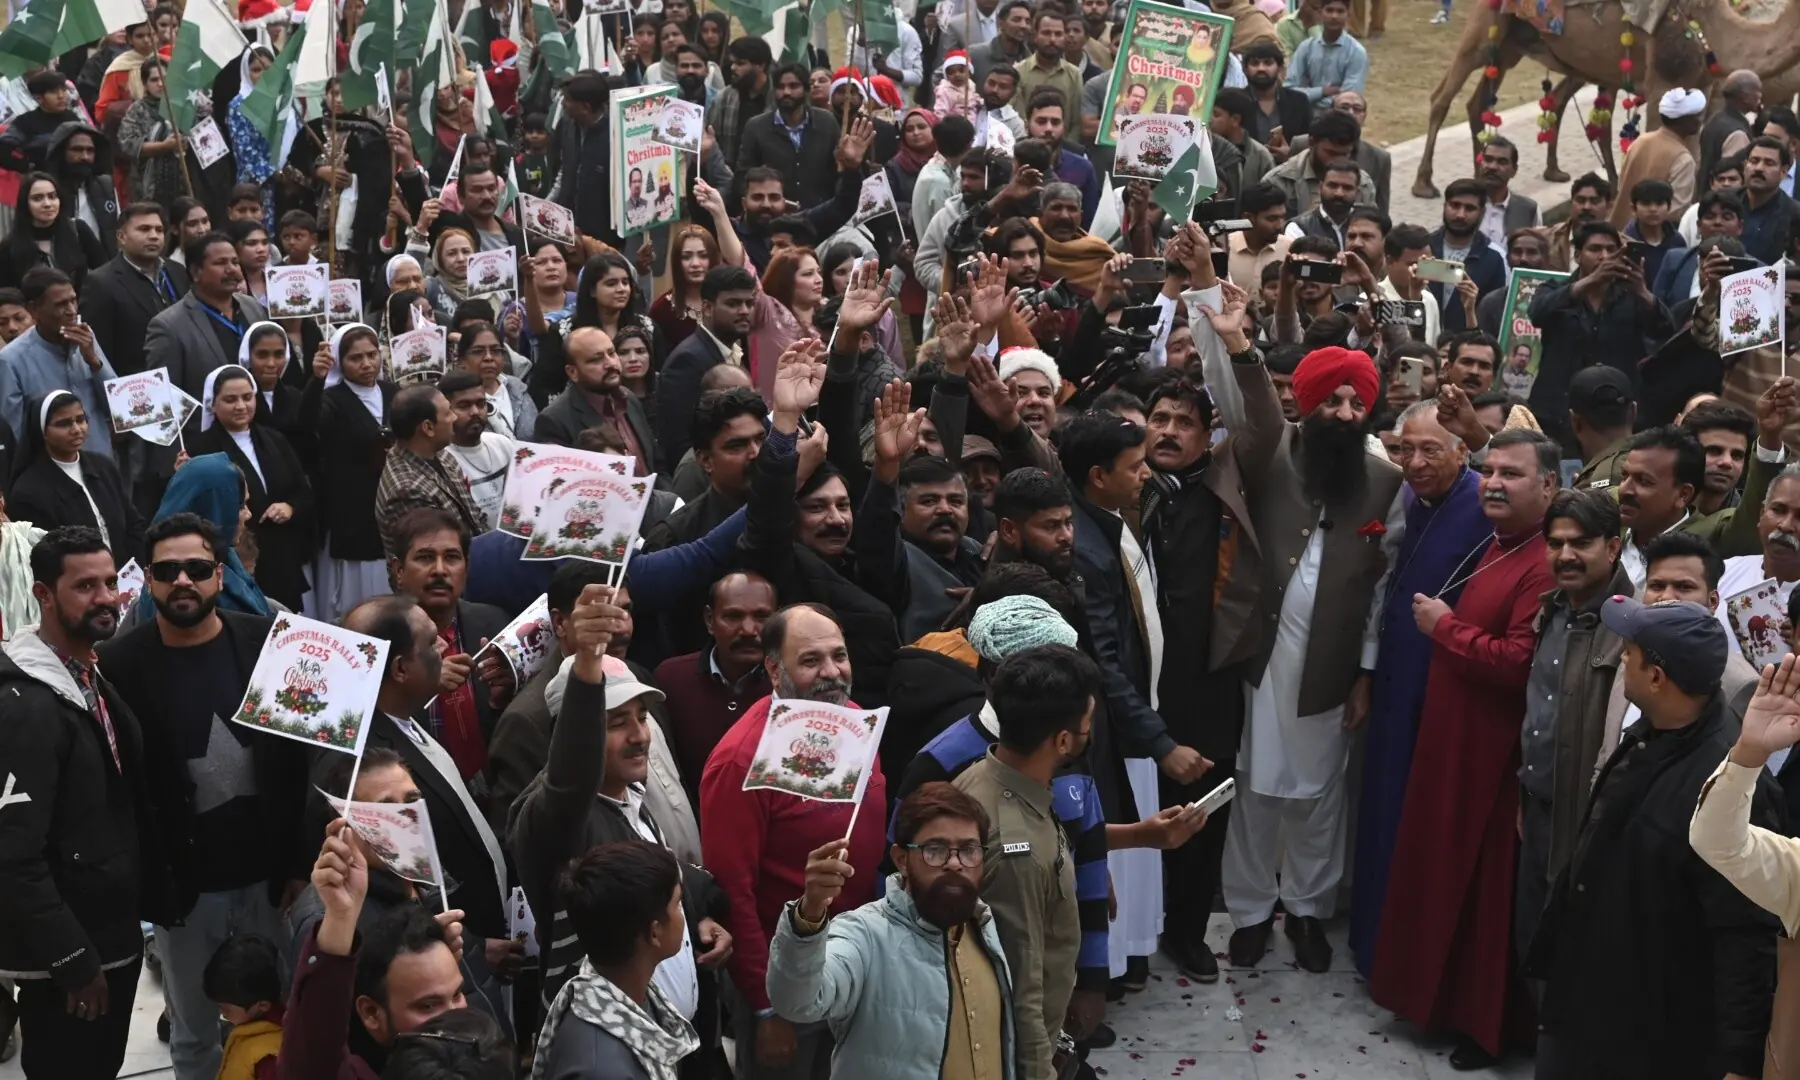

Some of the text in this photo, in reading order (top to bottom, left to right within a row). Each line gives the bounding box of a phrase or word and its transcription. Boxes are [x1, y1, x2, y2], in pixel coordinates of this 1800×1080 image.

[1129, 55, 1203, 87] Chrsitmas
[1126, 119, 1167, 135] CHRISTMAS
[1146, 126, 1169, 136] 2025
[627, 145, 672, 165] Chrsitmas
[1733, 286, 1752, 298] 2025
[1750, 277, 1769, 291] RALLY
[524, 456, 584, 473] CHRISTMAS
[554, 479, 608, 500] CHRISTMAS
[607, 483, 633, 502] RALLY
[577, 488, 608, 500] 2025
[276, 630, 361, 670] CHRISTMAS RALLY
[299, 642, 331, 662] 2025
[296, 657, 324, 676] Merry
[284, 666, 328, 695] Christmas
[777, 709, 866, 738] CHRISTMAS RALLY
[805, 720, 840, 736] 2025
[803, 731, 832, 747] Merry
[789, 739, 836, 763] Christmas
